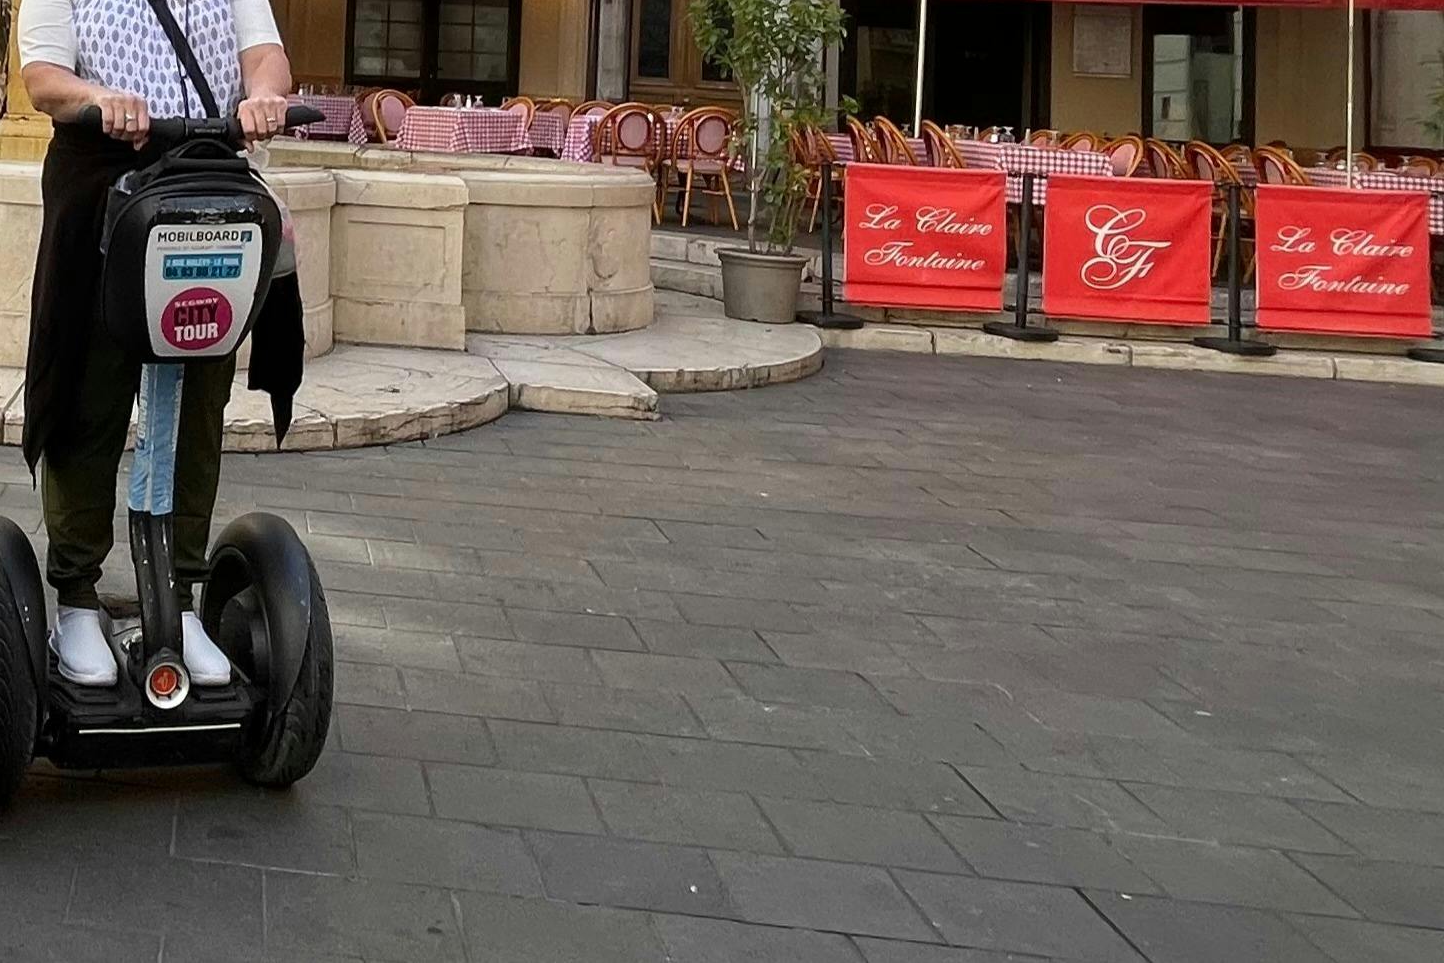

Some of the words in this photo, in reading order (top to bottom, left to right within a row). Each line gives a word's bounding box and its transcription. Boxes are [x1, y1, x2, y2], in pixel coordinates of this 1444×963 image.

[858, 203, 901, 230] La
[915, 206, 993, 236] Claire
[157, 230, 239, 243] MOBILBOARD
[1269, 225, 1316, 253] La
[1330, 228, 1414, 257] Claire
[863, 241, 986, 270] Fontaine
[1277, 264, 1410, 295] Fontaine
[173, 304, 218, 326] CITY
[174, 322, 218, 342] TOUR
